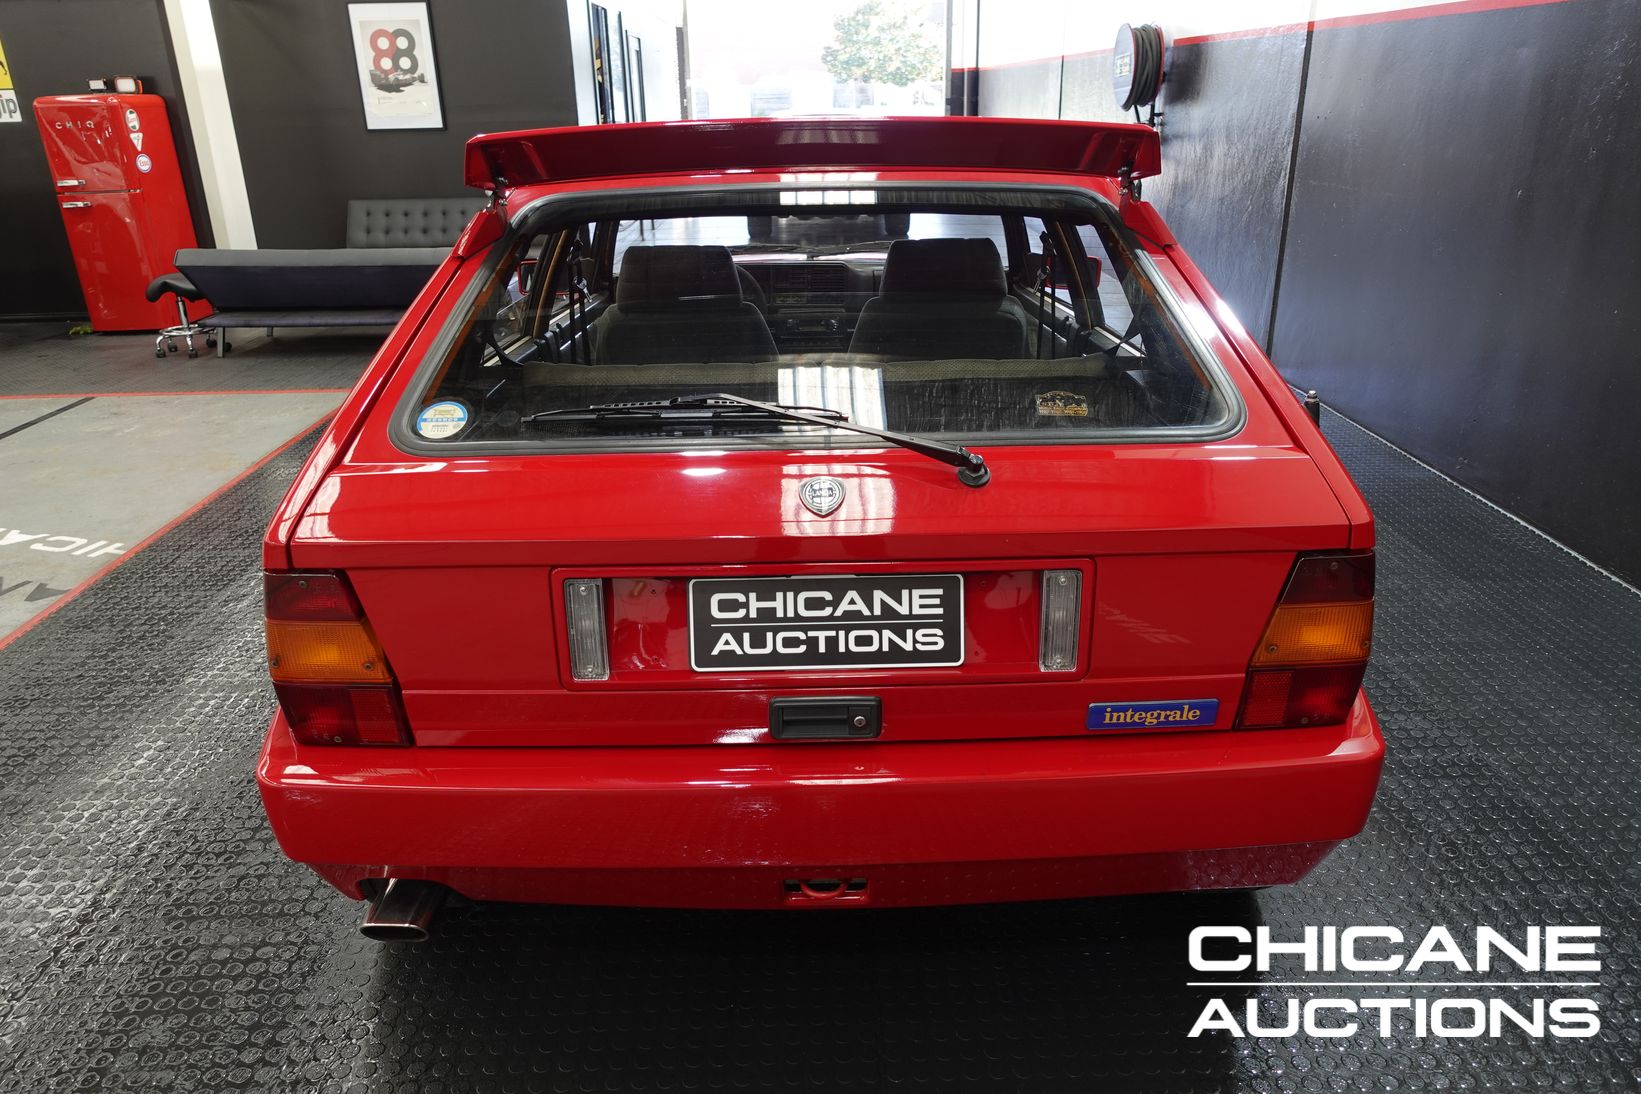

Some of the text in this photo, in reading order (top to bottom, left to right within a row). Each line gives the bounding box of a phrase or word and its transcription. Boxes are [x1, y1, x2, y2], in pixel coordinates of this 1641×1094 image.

[55, 120, 95, 129] CHIQ
[710, 588, 944, 619] CHICANE
[710, 628, 945, 655] AUCTIONS
[1103, 705, 1201, 726] integrale
